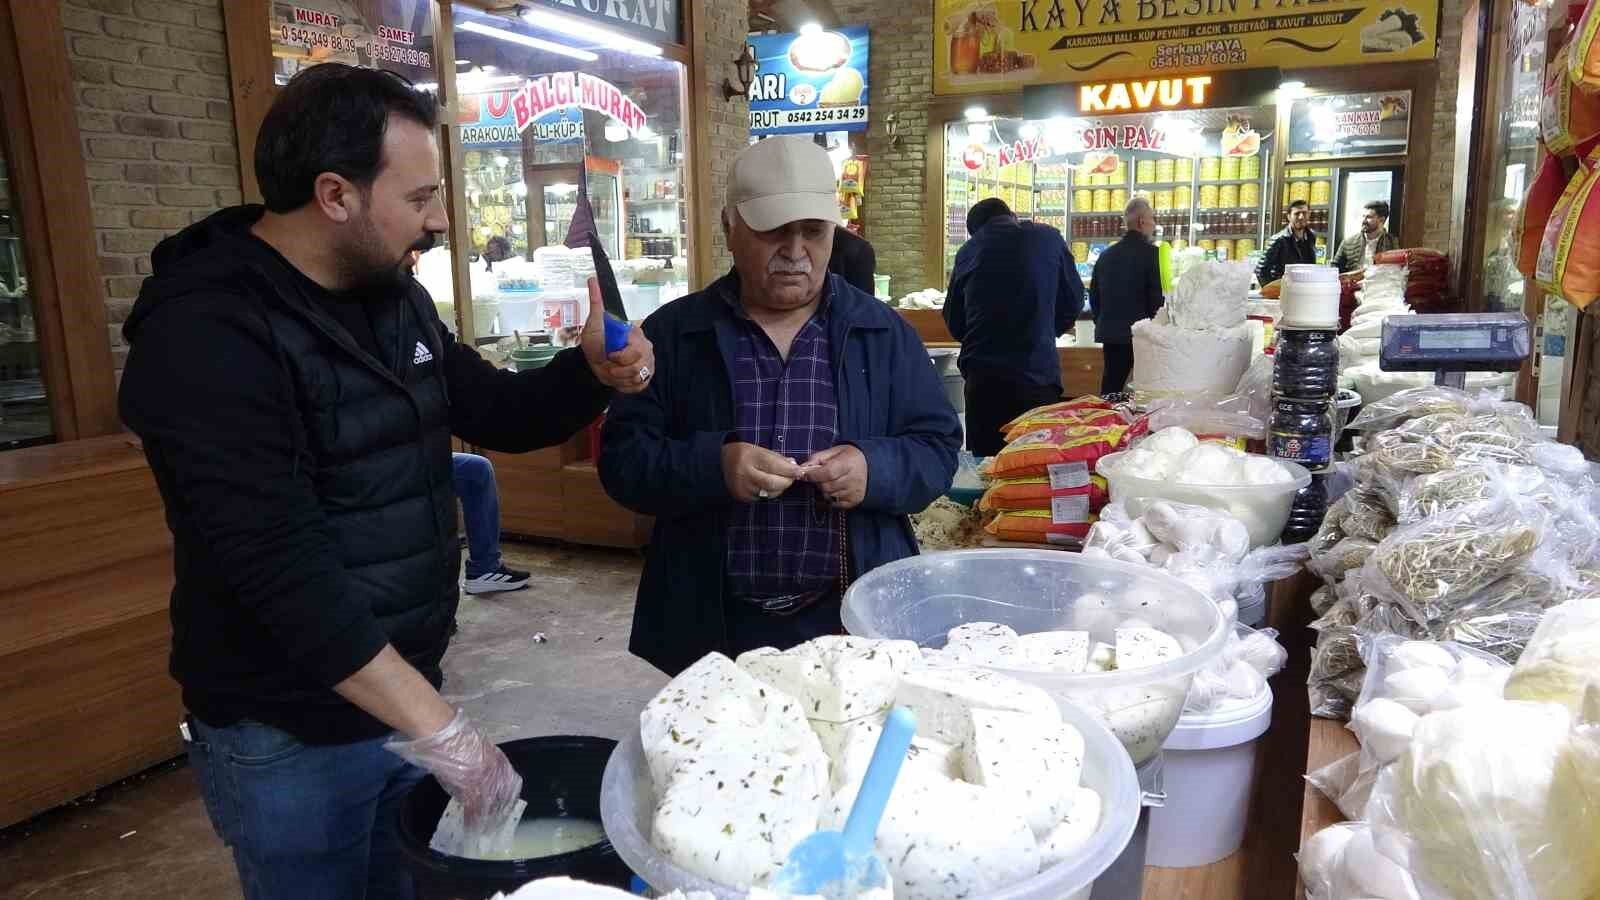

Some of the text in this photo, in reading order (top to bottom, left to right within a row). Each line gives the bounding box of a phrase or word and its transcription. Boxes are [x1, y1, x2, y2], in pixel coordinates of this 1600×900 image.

[295, 8, 338, 27] MURAT
[1018, 0, 1121, 32] KAYA
[1275, 16, 1306, 29] KAVUT
[1312, 13, 1345, 25] KURUT
[281, 25, 288, 40] 0
[291, 27, 308, 44] 542
[311, 31, 328, 48] 349
[378, 26, 413, 43] SAMET
[1158, 39, 1241, 56] Serkan KAYA
[1150, 48, 1246, 69] 0541 387 60 21
[749, 74, 785, 101] ARI
[1080, 76, 1212, 111] KAVUT
[581, 78, 645, 129] MURAT
[788, 113, 811, 123] 0542
[815, 111, 833, 121] 254
[837, 109, 849, 120] 34
[852, 107, 865, 119] 29
